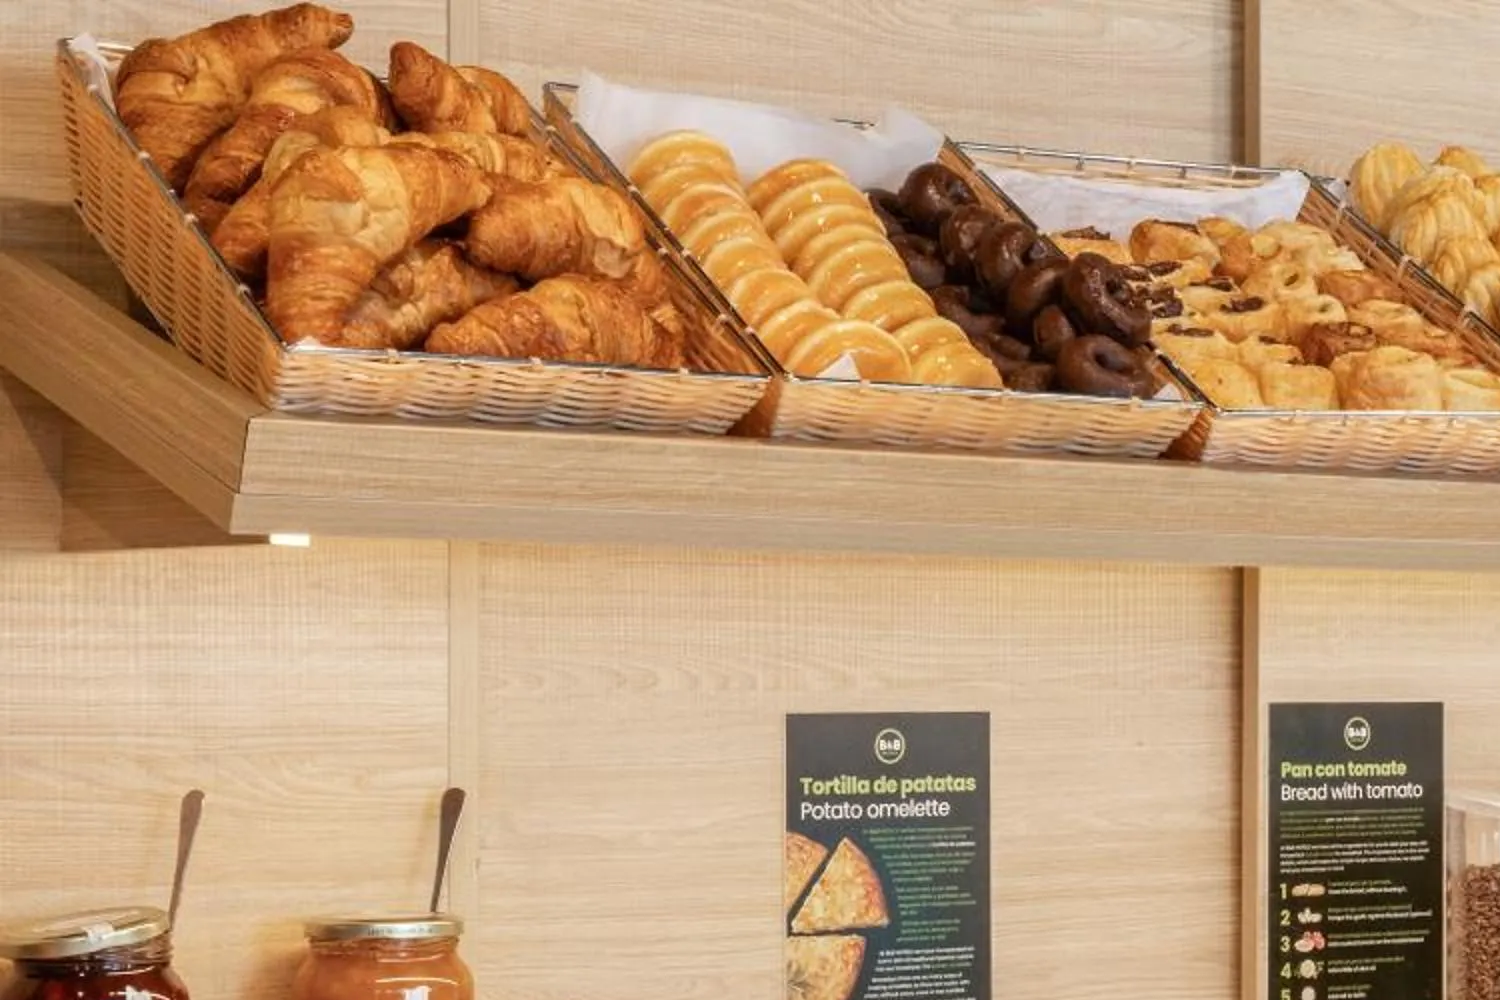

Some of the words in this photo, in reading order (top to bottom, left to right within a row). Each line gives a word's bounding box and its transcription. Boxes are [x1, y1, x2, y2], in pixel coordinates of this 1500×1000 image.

[1280, 761, 1312, 778] Pan
[1315, 763, 1345, 777] con
[1347, 760, 1407, 777] tomate
[800, 774, 870, 795] Tortilla
[873, 776, 898, 793] de
[901, 775, 976, 798] patatas
[1280, 783, 1328, 801] Bread
[1331, 782, 1363, 800] with
[1366, 783, 1423, 799] tomato
[800, 801, 863, 820] Potato
[867, 800, 950, 819] omelette
[1280, 883, 1288, 900] 1
[1280, 909, 1291, 926] 2
[1280, 936, 1291, 953] 3
[1280, 962, 1292, 979] 4
